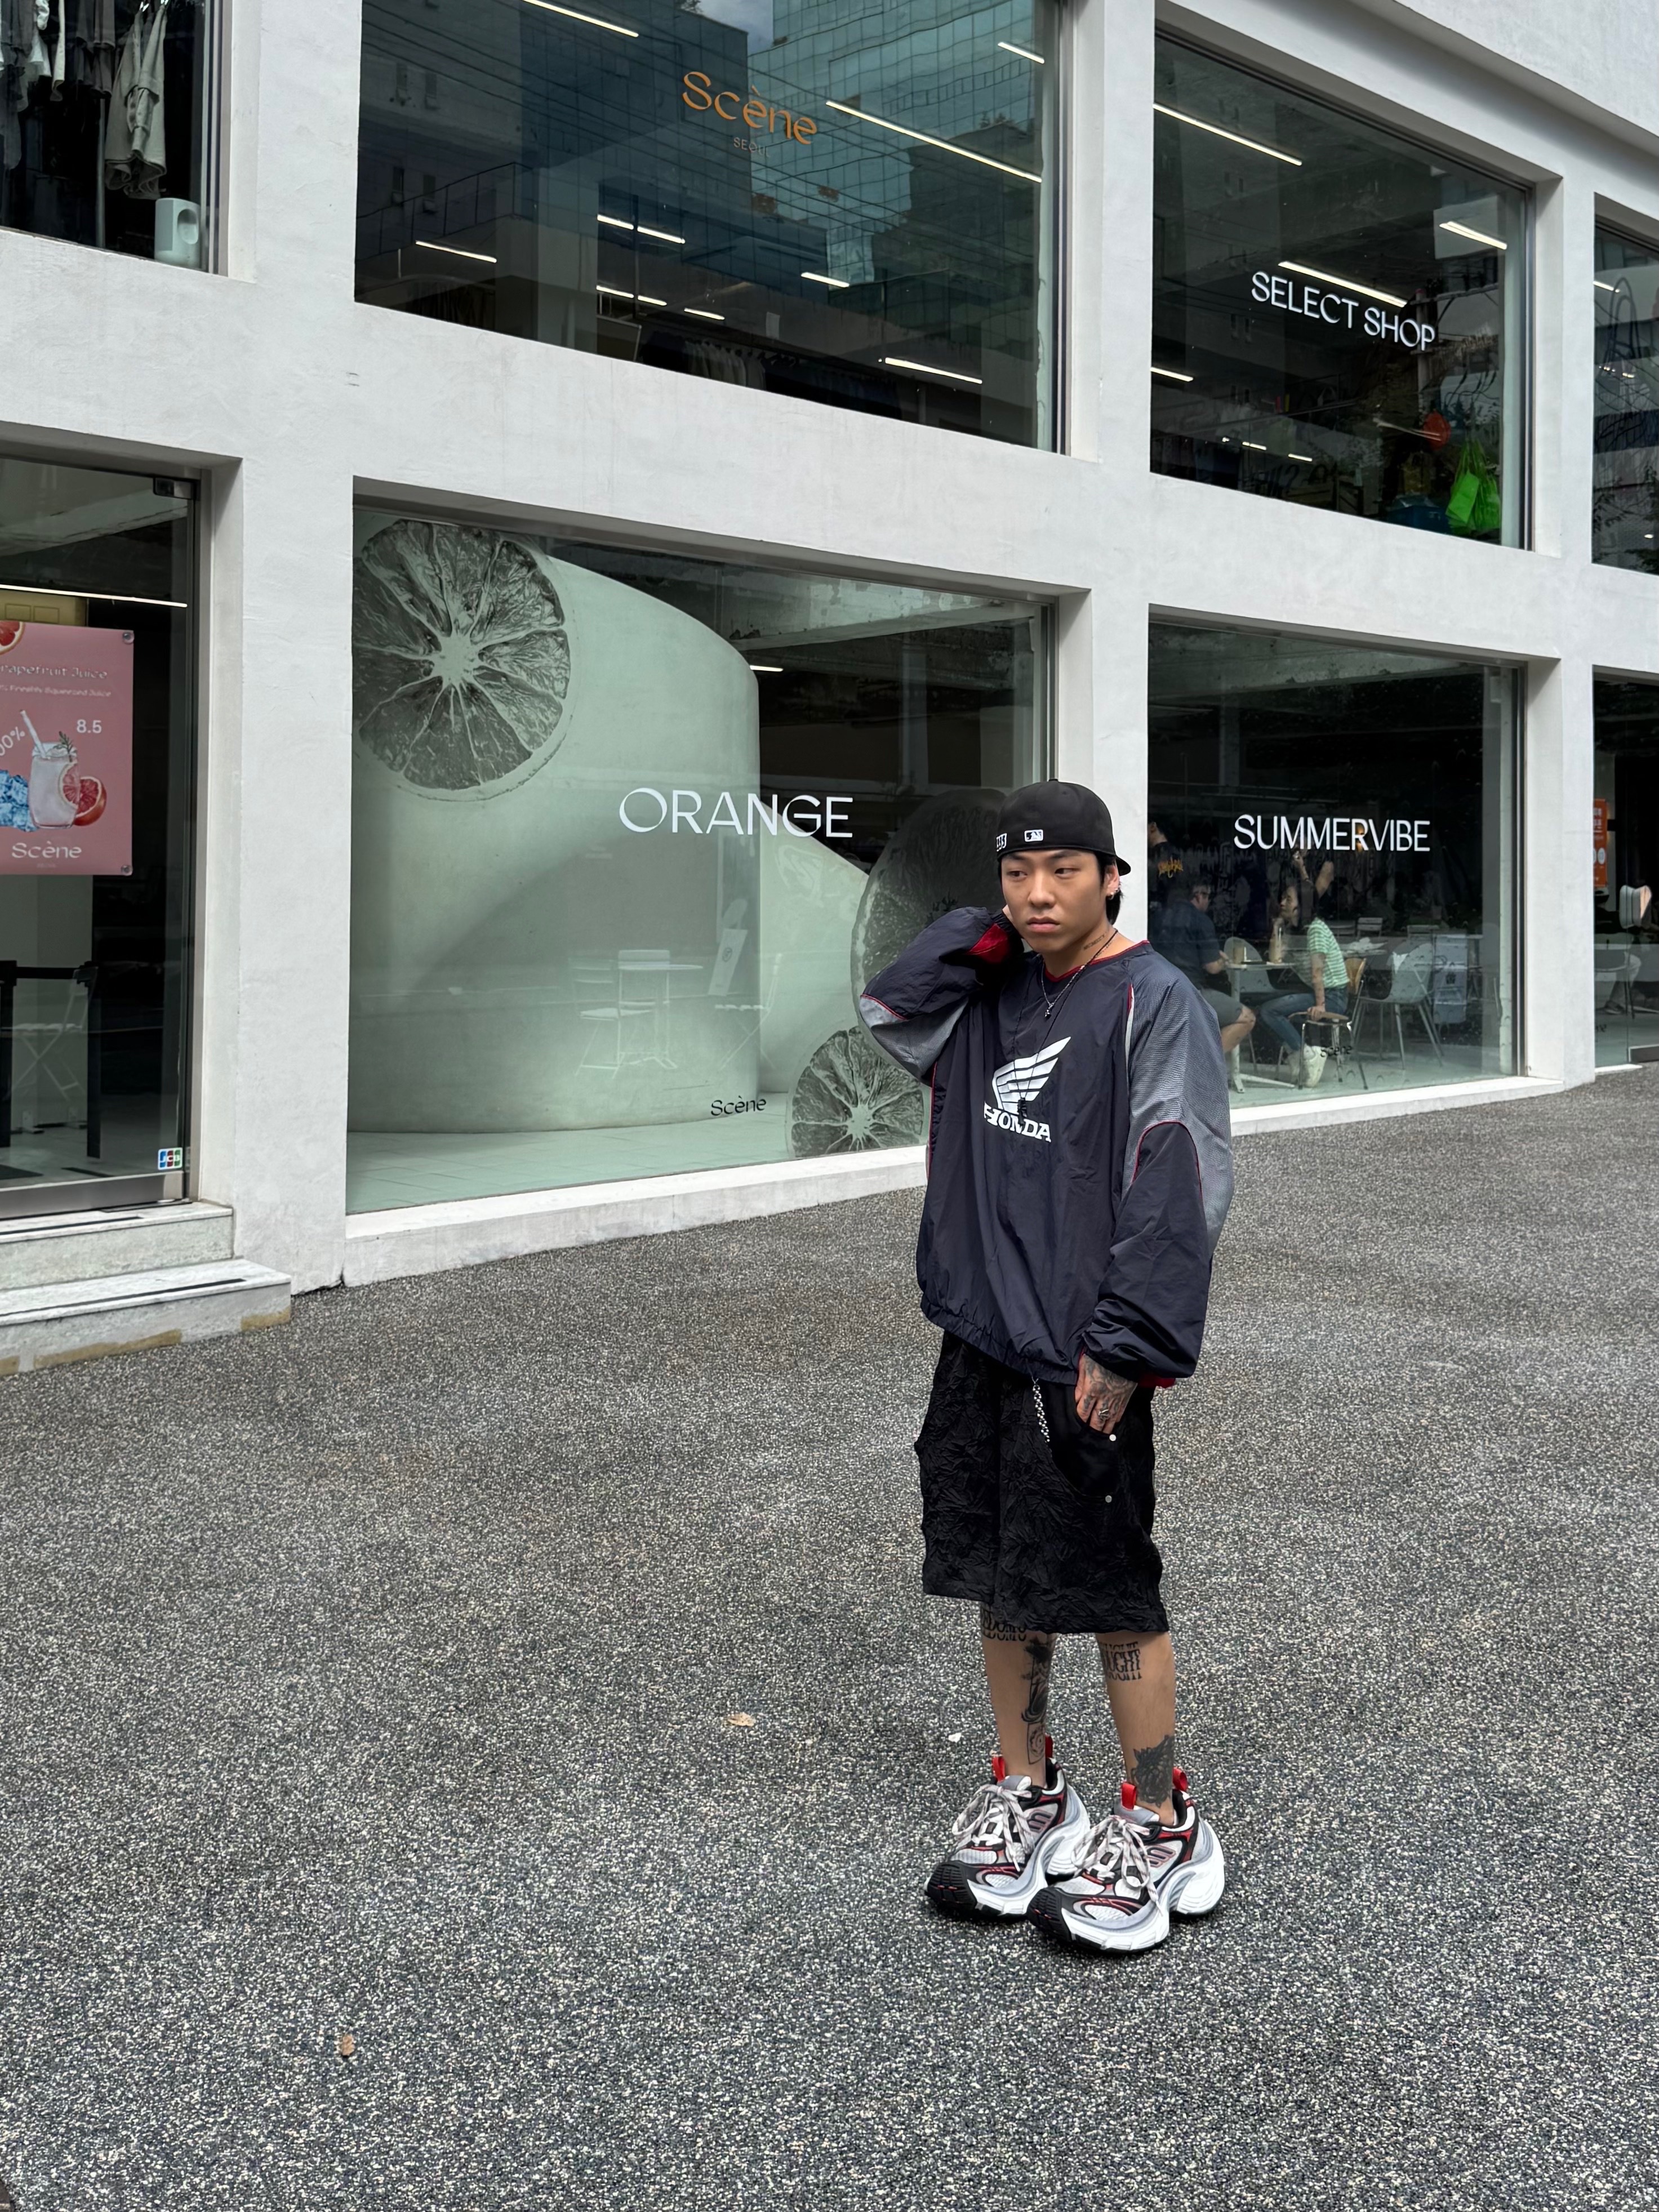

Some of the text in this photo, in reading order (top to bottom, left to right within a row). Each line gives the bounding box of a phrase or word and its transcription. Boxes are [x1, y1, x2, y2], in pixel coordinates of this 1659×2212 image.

[682, 72, 817, 145] Scène
[733, 137, 770, 157] SEOUL
[1252, 271, 1435, 350] SELECT SHOP
[77, 719, 102, 733] 8.5
[619, 787, 853, 838] ORANGE
[11, 840, 82, 858] Scène
[1234, 814, 1430, 852] SUMMERVIBE
[710, 1095, 767, 1116] Scène
[984, 1100, 1052, 1143] HONDA
